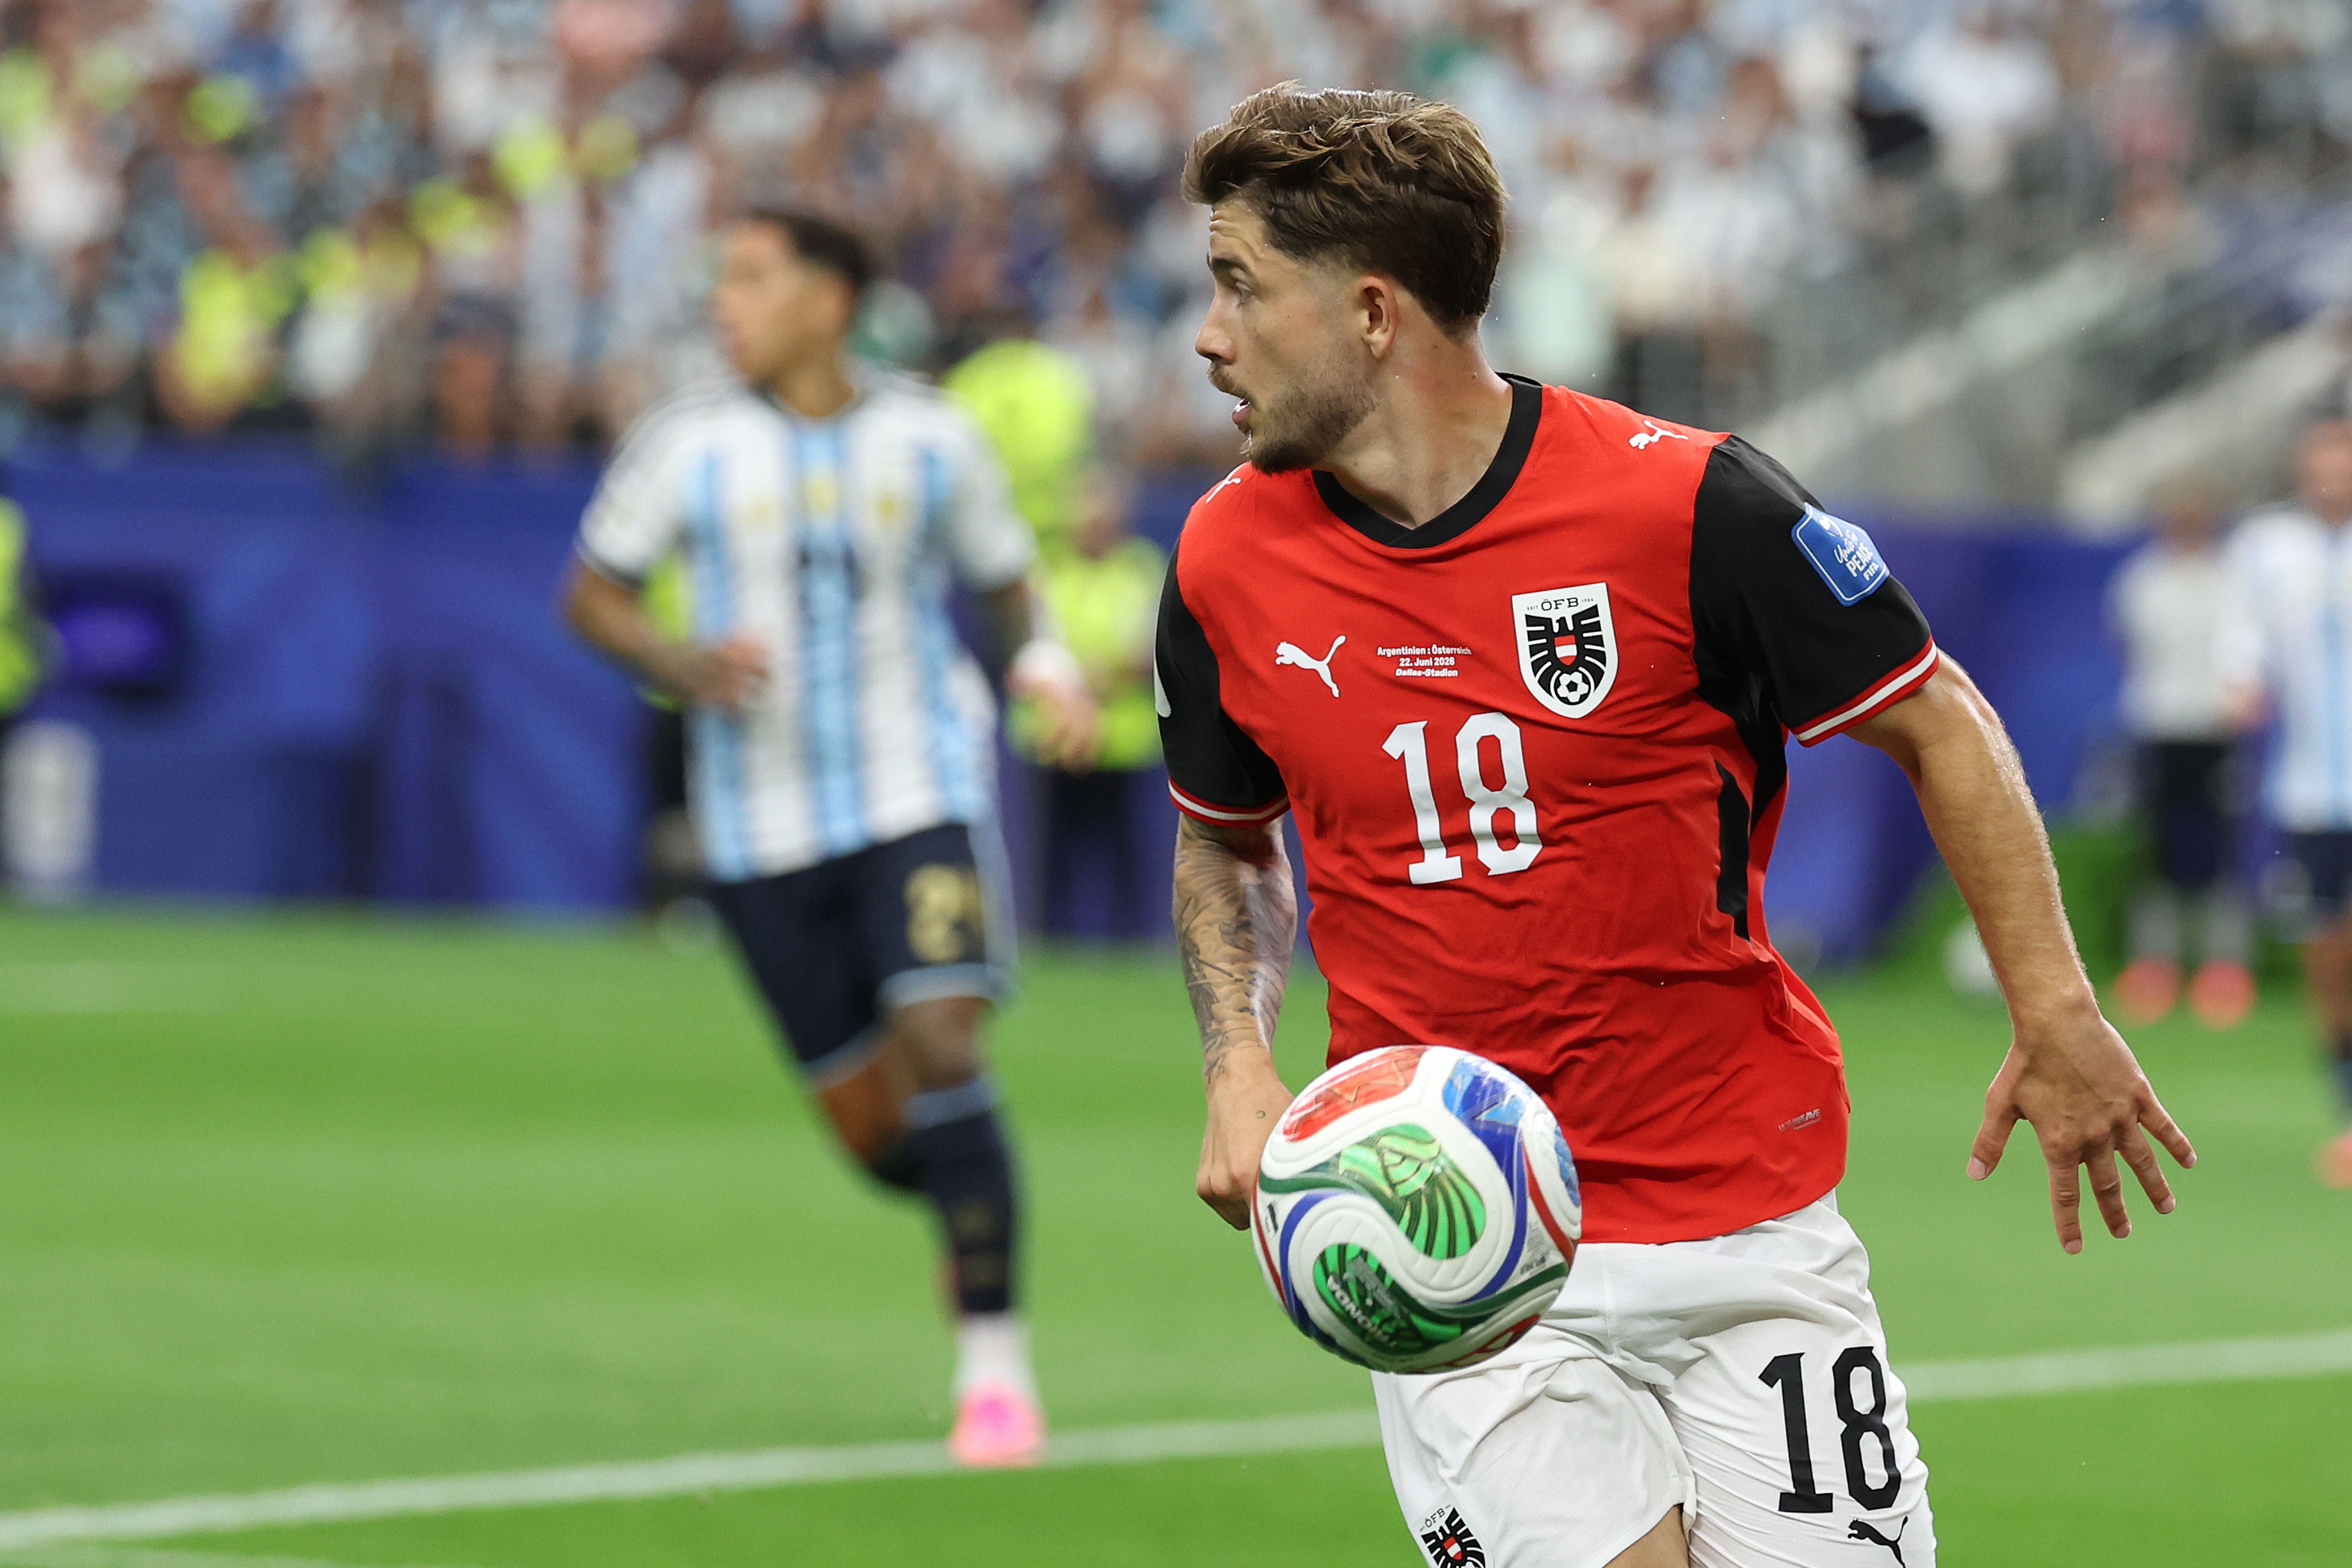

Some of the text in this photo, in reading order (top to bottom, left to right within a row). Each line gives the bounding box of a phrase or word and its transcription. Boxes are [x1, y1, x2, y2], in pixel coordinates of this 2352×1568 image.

[1863, 562, 1879, 581] FIFA
[1541, 597, 1579, 611] ÖFB
[1377, 646, 1426, 657] Argentinien
[1432, 644, 1472, 655] Österreich
[1399, 657, 1455, 667] 22. Juni 2026
[1382, 712, 1543, 884] 18
[1758, 1346, 1901, 1513] 18
[1425, 1508, 1445, 1528] ÖFB
